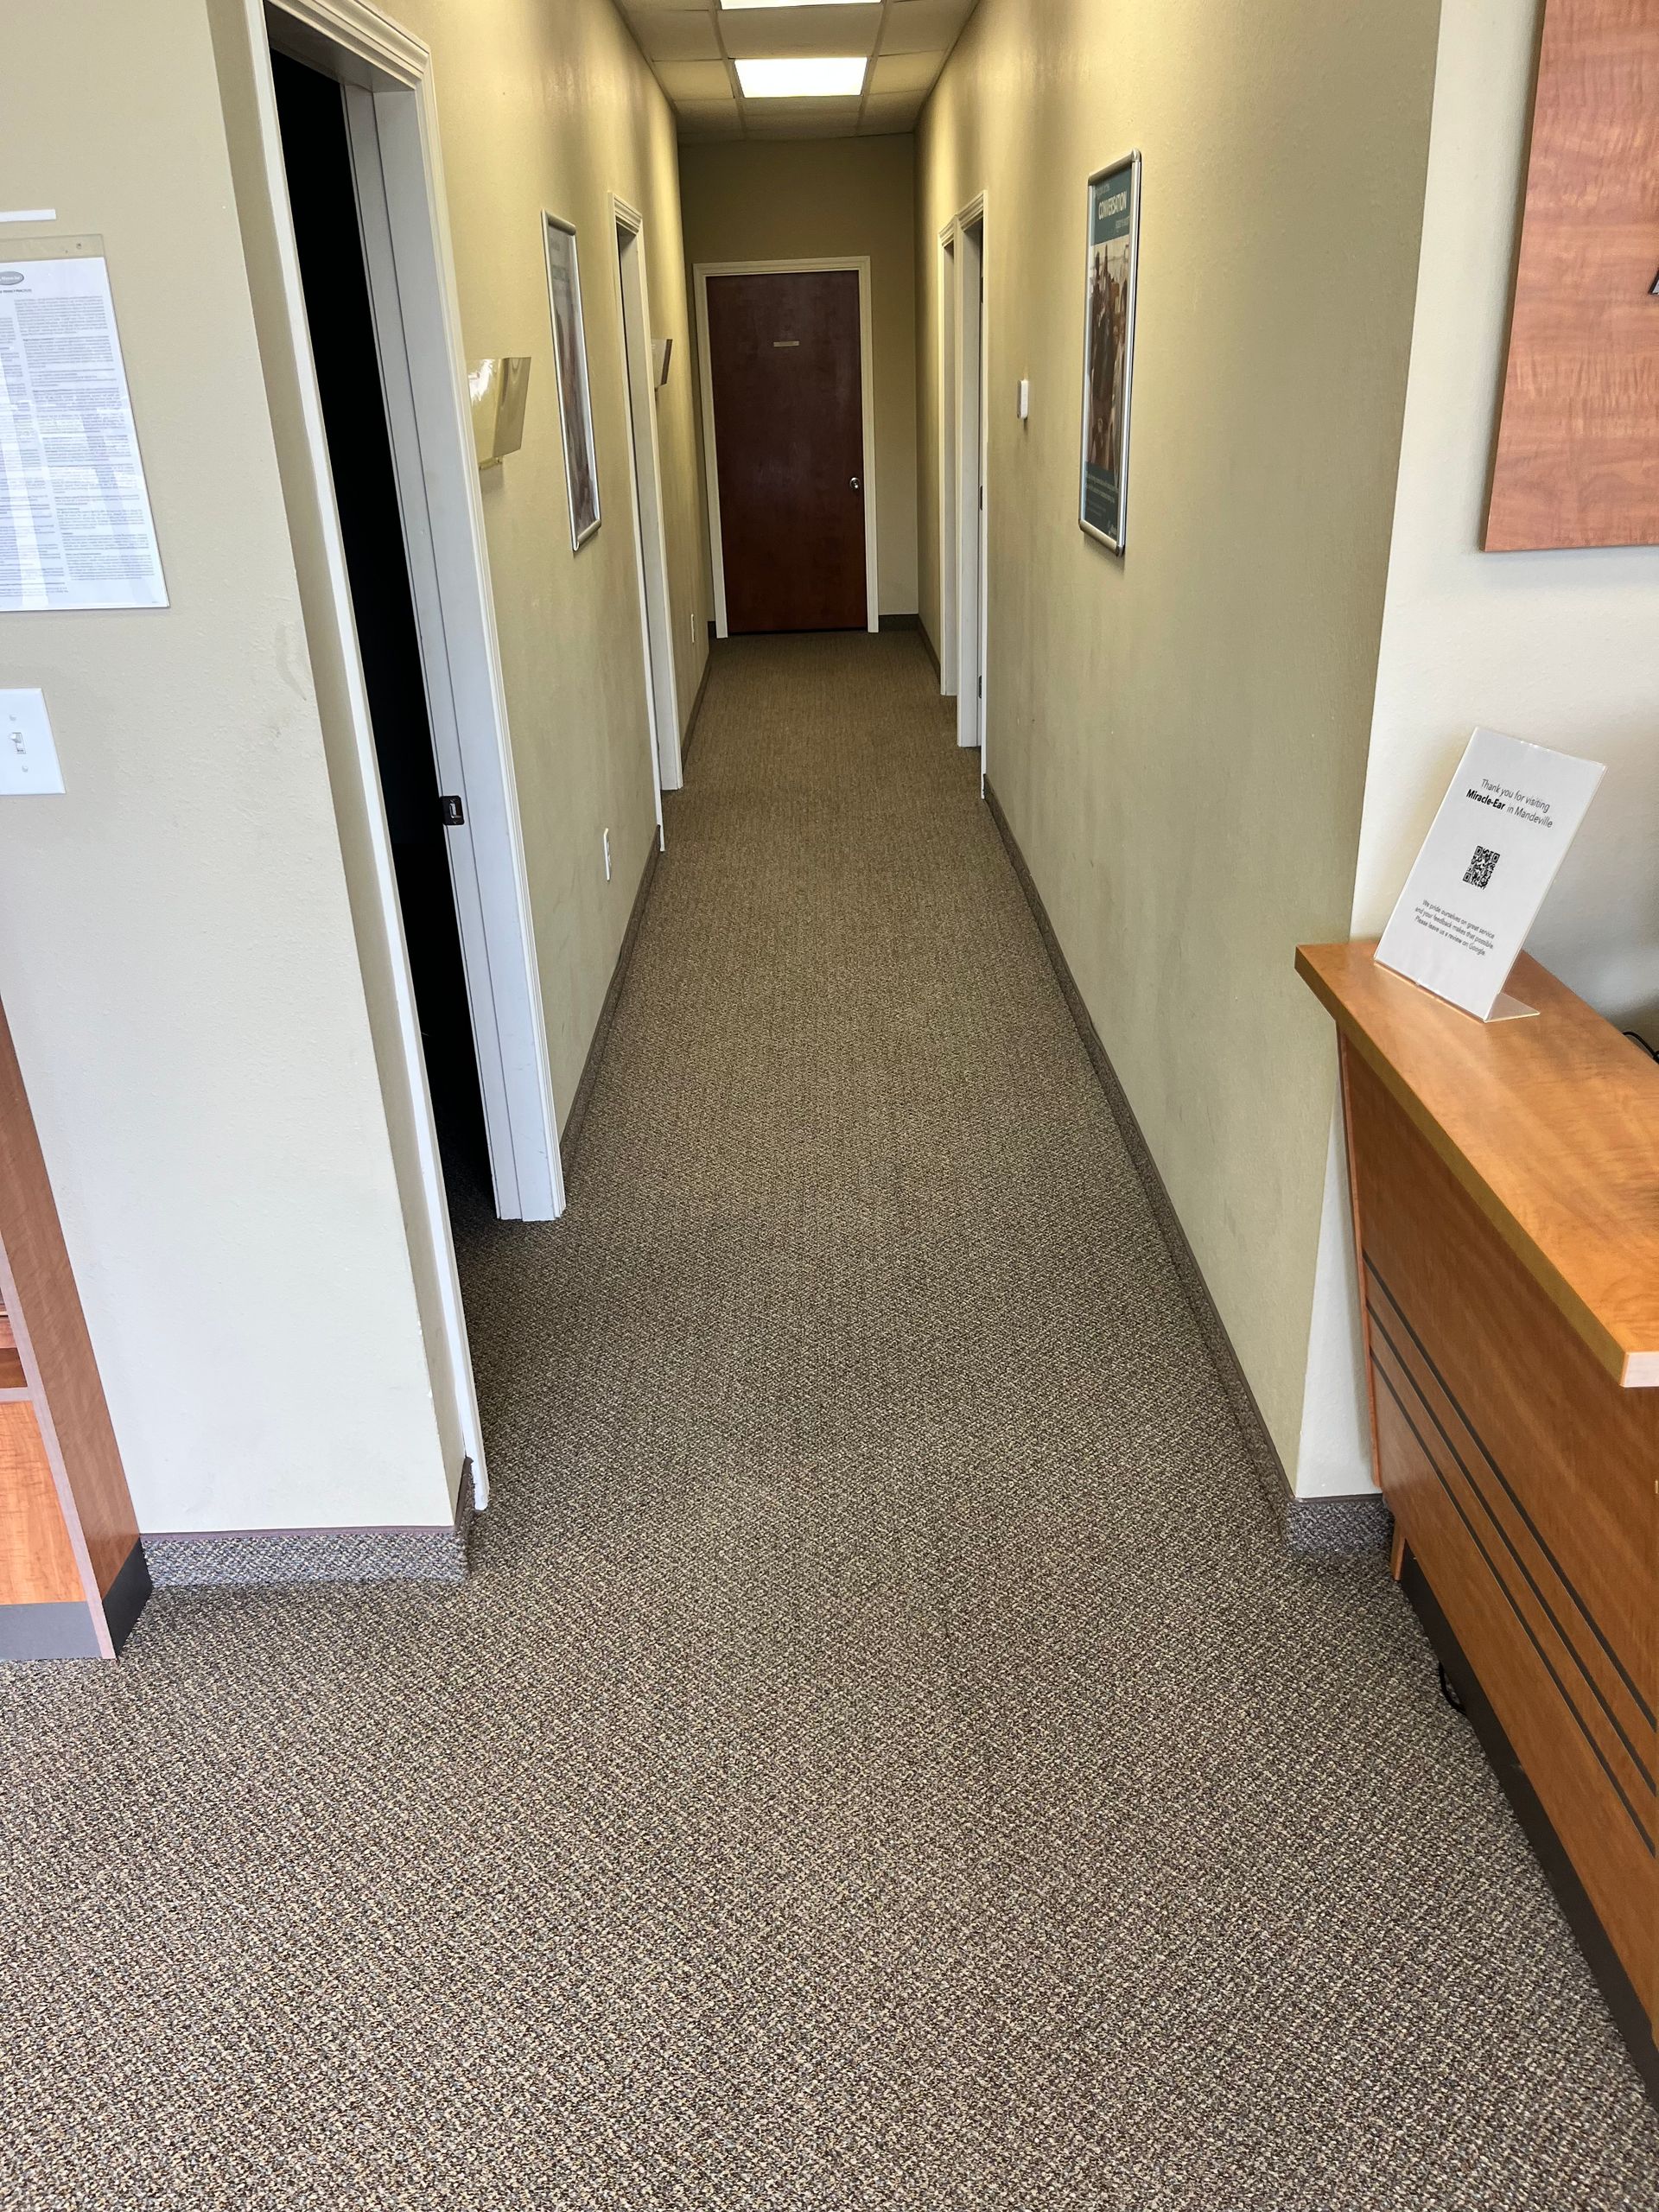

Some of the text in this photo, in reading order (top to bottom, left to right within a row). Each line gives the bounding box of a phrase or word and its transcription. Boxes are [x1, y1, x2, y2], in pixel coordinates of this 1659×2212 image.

[1466, 789, 1553, 828] Miracle-Ear in Mandeville
[1481, 779, 1550, 813] Thank you for visiting
[1414, 915, 1427, 926] Please
[1427, 922, 1439, 932] leave
[1447, 933, 1462, 944] review
[1429, 904, 1440, 912] pride
[1441, 910, 1461, 923] ourselves
[1466, 923, 1479, 931] great
[1479, 928, 1495, 939] service
[1433, 913, 1452, 928] feedback
[1452, 925, 1466, 935] makes
[1465, 931, 1475, 940] that
